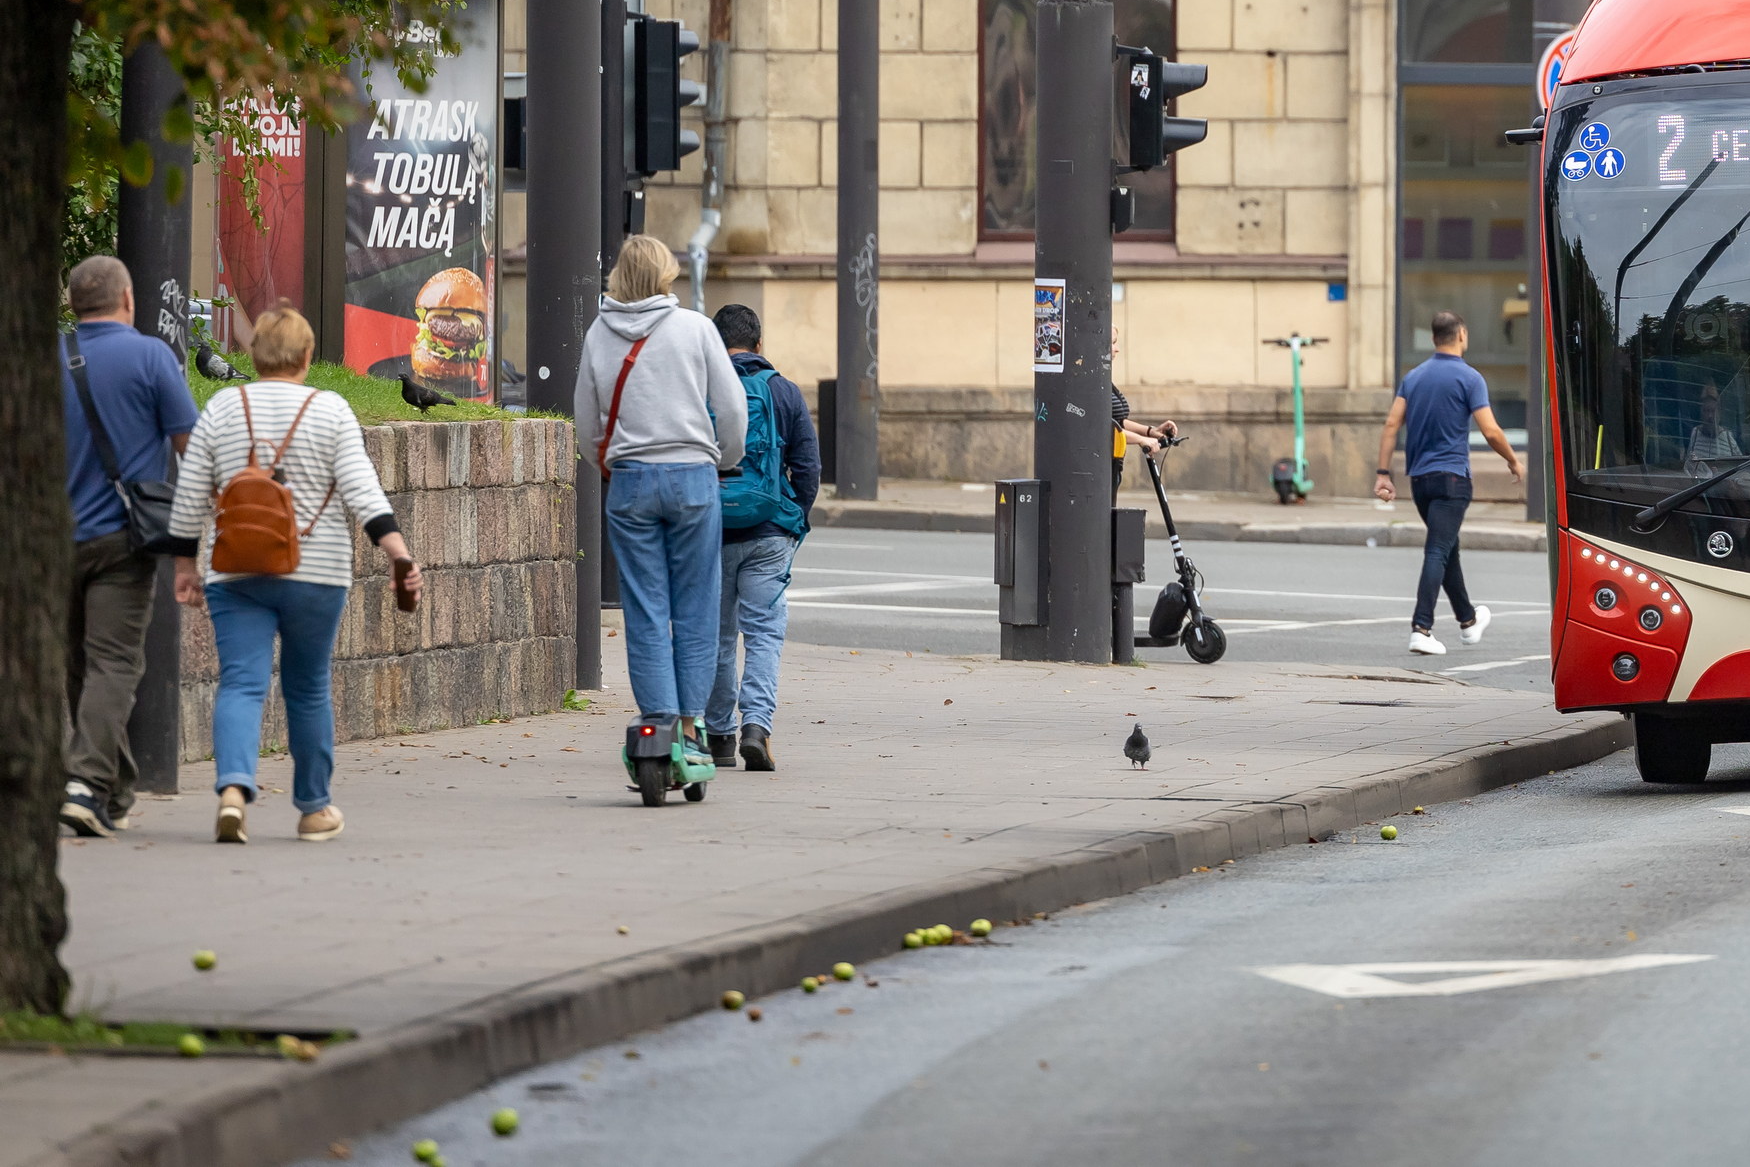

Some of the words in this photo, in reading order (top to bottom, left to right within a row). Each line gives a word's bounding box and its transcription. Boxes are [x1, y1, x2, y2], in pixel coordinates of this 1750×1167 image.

[367, 99, 479, 142] ATRASK
[1657, 114, 1687, 181] 2
[373, 152, 475, 204] TOBULĄ
[367, 197, 456, 257] MAČĄ
[1019, 494, 1032, 503] 62
